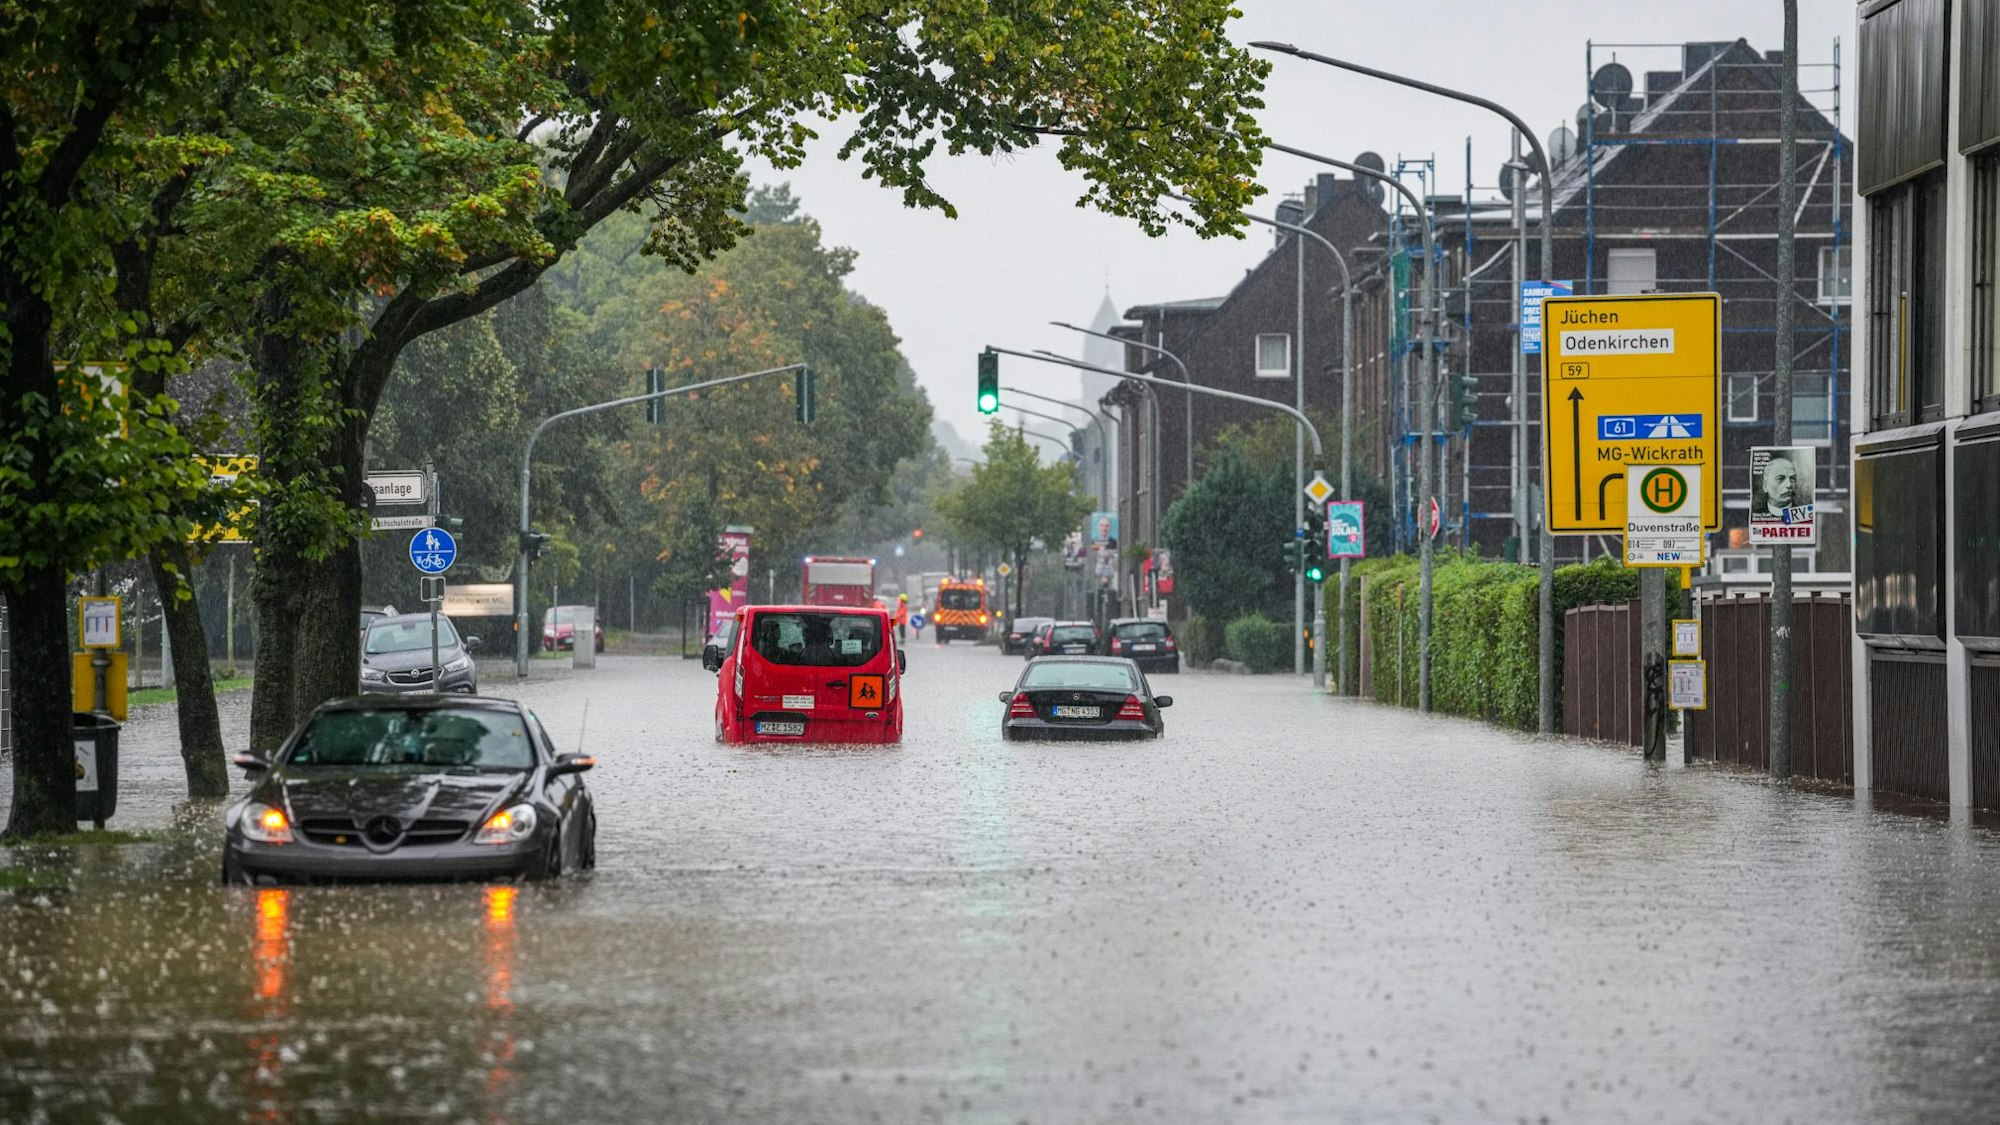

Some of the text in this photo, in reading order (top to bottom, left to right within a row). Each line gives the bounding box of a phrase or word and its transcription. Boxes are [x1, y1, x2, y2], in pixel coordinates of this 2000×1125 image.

[1561, 310, 1619, 325] Jüchen
[1565, 335, 1669, 350] Odenkirchen
[1568, 365, 1582, 376] 59
[1614, 422, 1626, 433] 61
[1598, 446, 1703, 461] MG-Wickrath
[371, 482, 412, 497] sanlage
[1655, 478, 1673, 503] H
[1628, 523, 1700, 532] Duvenstraße
[1752, 527, 1810, 537] Die PARTEI
[1627, 540, 1640, 549] 014
[1663, 540, 1676, 549] 097
[1657, 552, 1680, 560] NEW
